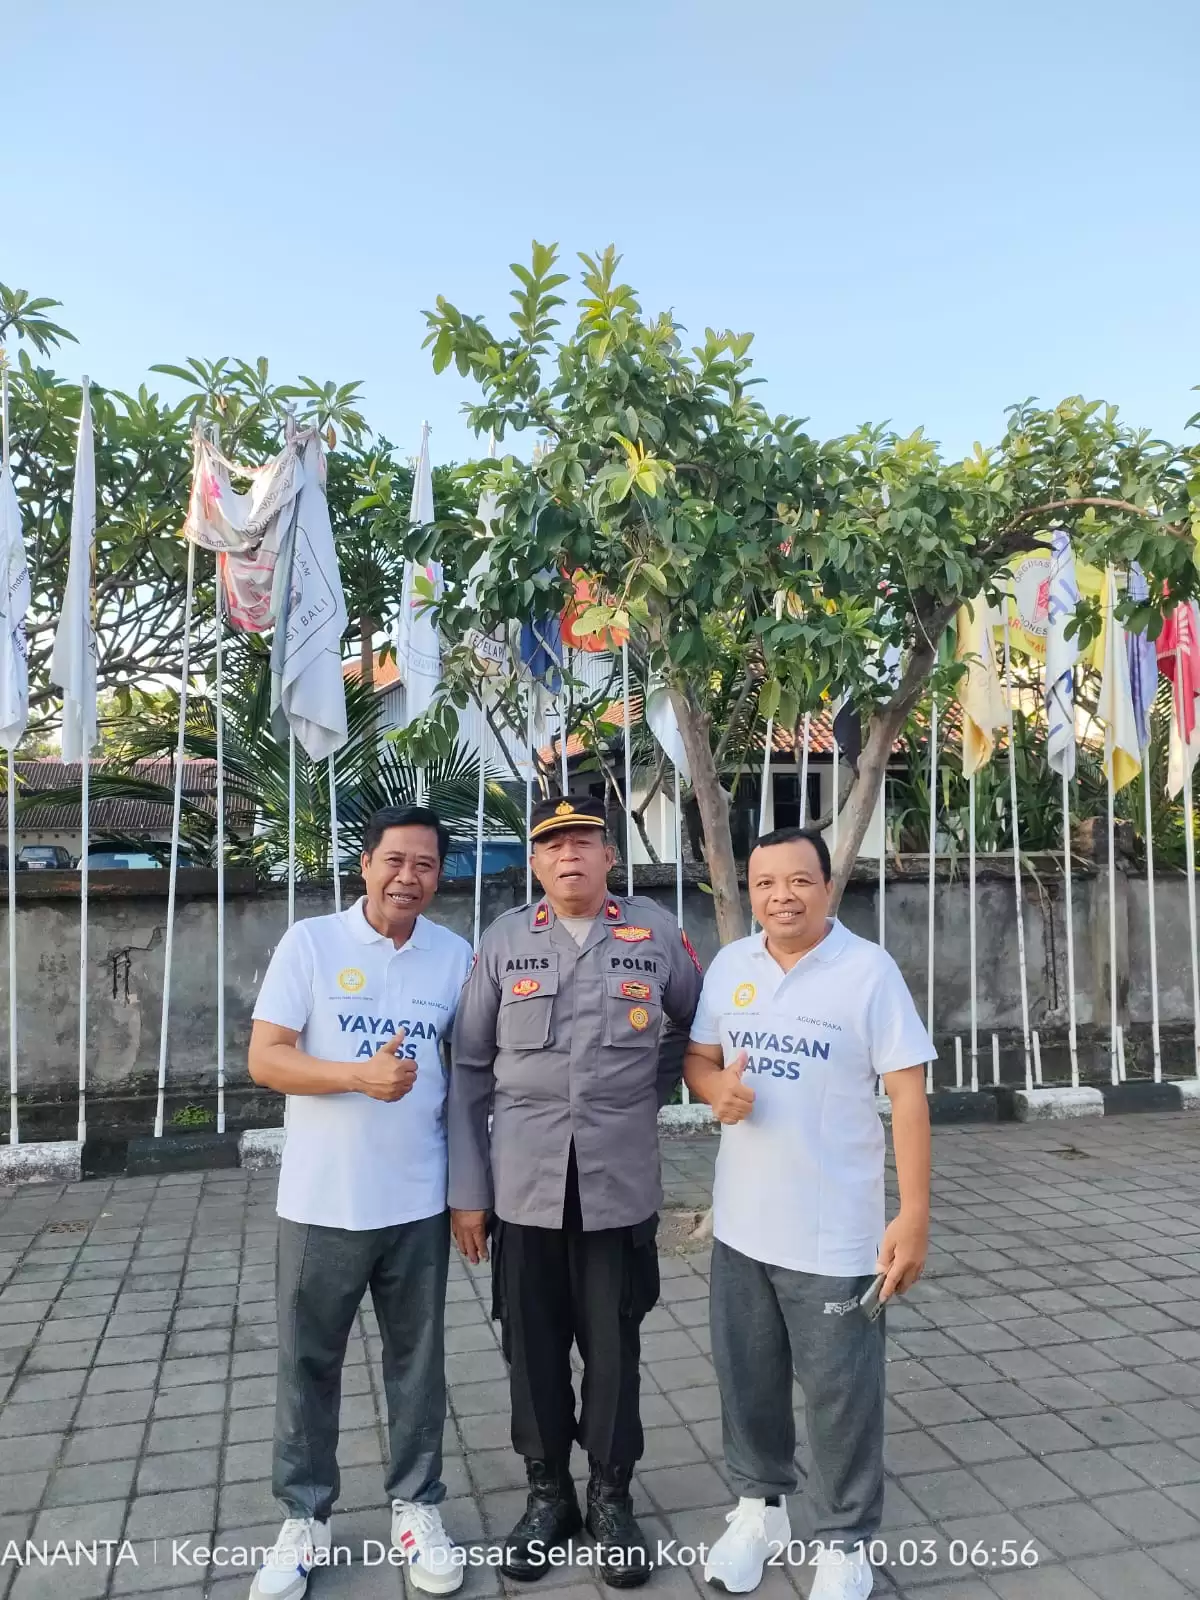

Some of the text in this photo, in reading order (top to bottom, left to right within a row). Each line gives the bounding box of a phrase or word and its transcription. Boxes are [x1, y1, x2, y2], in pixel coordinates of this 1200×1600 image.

[300, 598, 329, 627] BALI
[505, 957, 657, 974] ALIT.S POLRI
[822, 1020, 842, 1032] RAKA
[728, 1030, 830, 1061] YAYASAN
[743, 1055, 801, 1081] APSS
